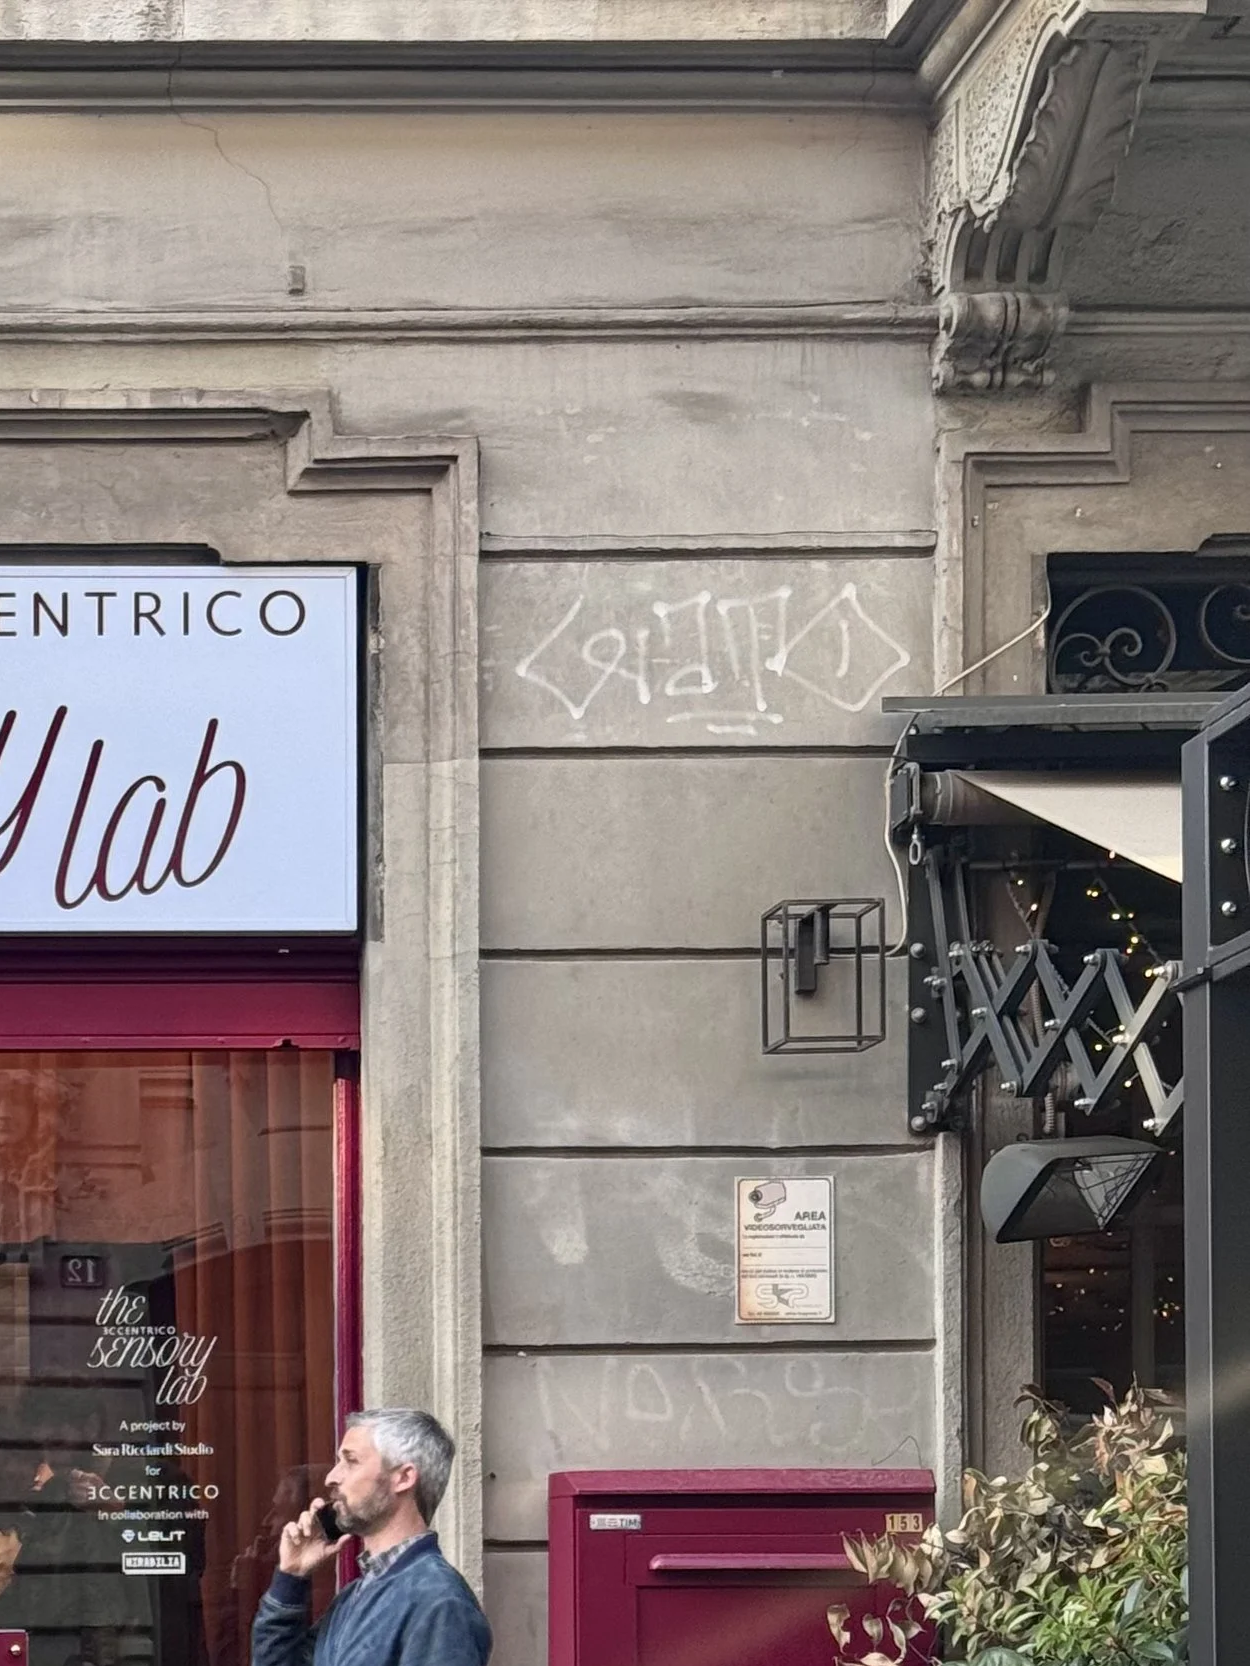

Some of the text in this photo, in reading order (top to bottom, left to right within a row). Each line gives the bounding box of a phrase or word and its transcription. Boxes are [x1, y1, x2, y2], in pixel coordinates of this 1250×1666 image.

[54, 717, 247, 910] lab
[794, 1211, 826, 1221] AREA
[744, 1223, 827, 1231] VIDEOSORVEGLIATA
[95, 1285, 146, 1326] the
[86, 1332, 218, 1377] sensory
[155, 1365, 208, 1405] lab
[119, 1420, 186, 1433] A project by
[92, 1442, 214, 1457] Sara Ricciardi Studio
[144, 1465, 162, 1476] for
[110, 1509, 183, 1520] collaboration
[184, 1509, 210, 1520] with
[889, 1514, 920, 1530] 153
